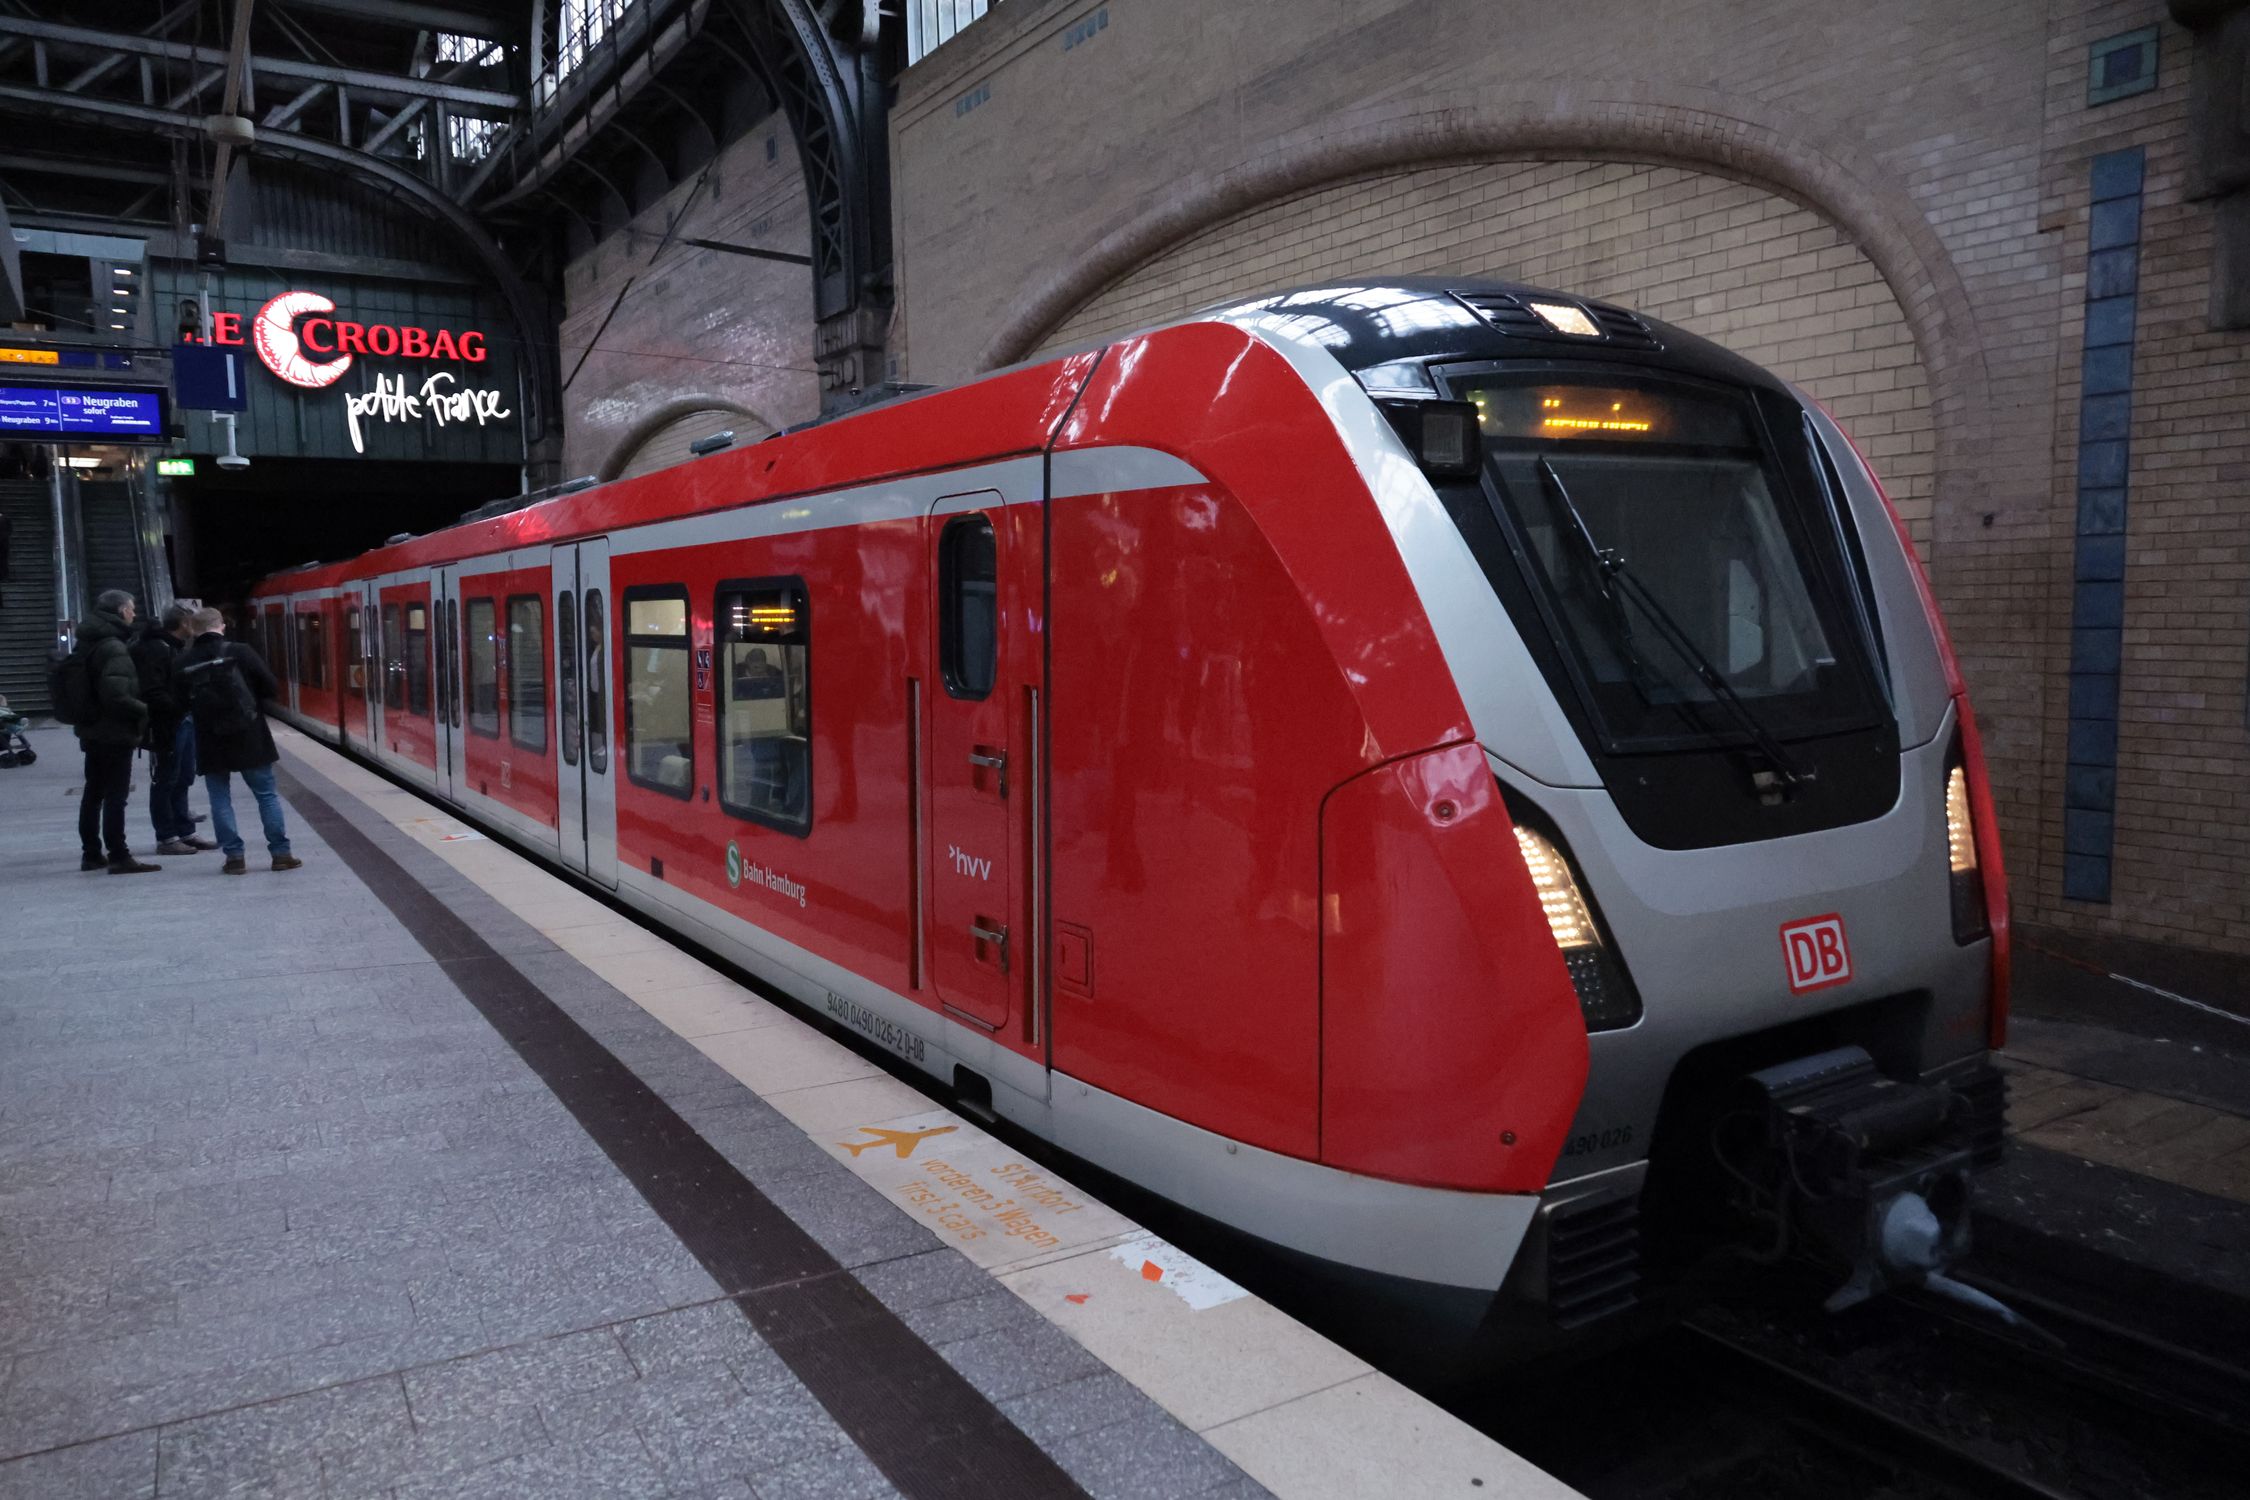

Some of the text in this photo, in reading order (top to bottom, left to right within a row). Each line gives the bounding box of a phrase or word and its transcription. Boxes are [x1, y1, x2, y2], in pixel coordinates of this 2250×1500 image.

[302, 318, 487, 362] CROBAG
[1, 416, 41, 425] Neugraben
[43, 399, 48, 407] 7
[83, 396, 138, 409] Neugraben
[83, 407, 106, 415] sofort
[420, 372, 511, 427] France
[743, 858, 764, 886] Bahn
[765, 866, 806, 908] Hamburg
[1788, 925, 1845, 983] DB
[827, 992, 849, 1020] 9480
[850, 1005, 873, 1034] 0490
[875, 1017, 903, 1051] 026-2
[896, 1180, 942, 1206] first
[938, 1213, 987, 1241] cars
[920, 1159, 994, 1203] vorderen
[993, 1207, 1060, 1248] Wagen
